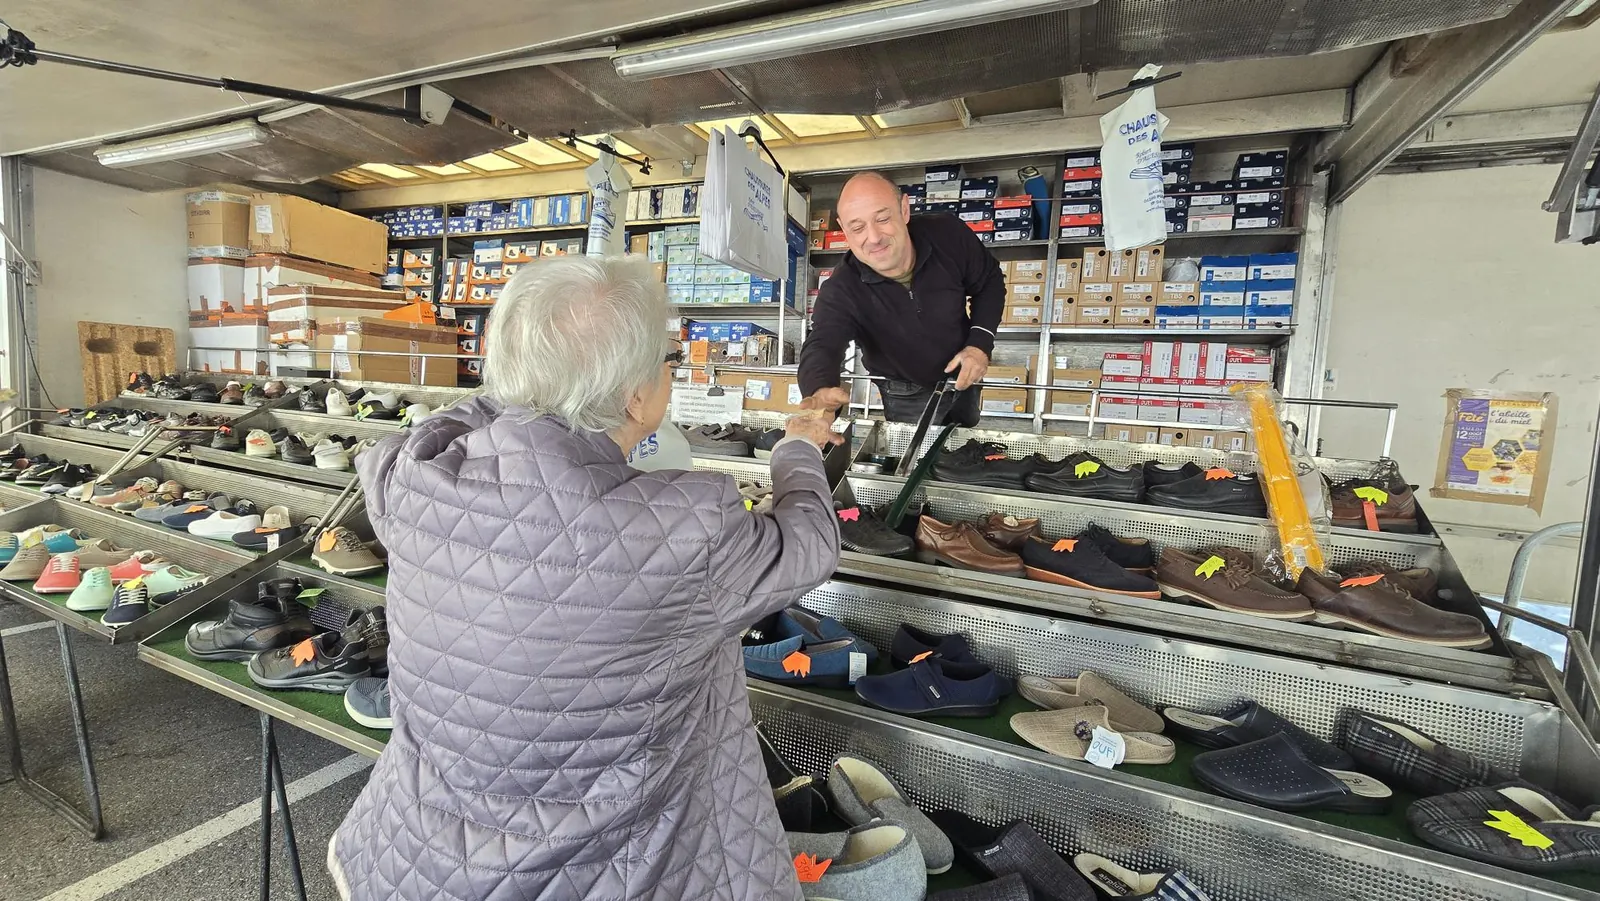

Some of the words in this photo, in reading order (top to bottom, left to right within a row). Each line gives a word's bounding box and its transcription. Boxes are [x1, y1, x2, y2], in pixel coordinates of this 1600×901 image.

[1128, 133, 1148, 146] DES
[1510, 418, 1532, 426] miel
[1456, 430, 1468, 440] 12
[1098, 872, 1128, 894] airplum
